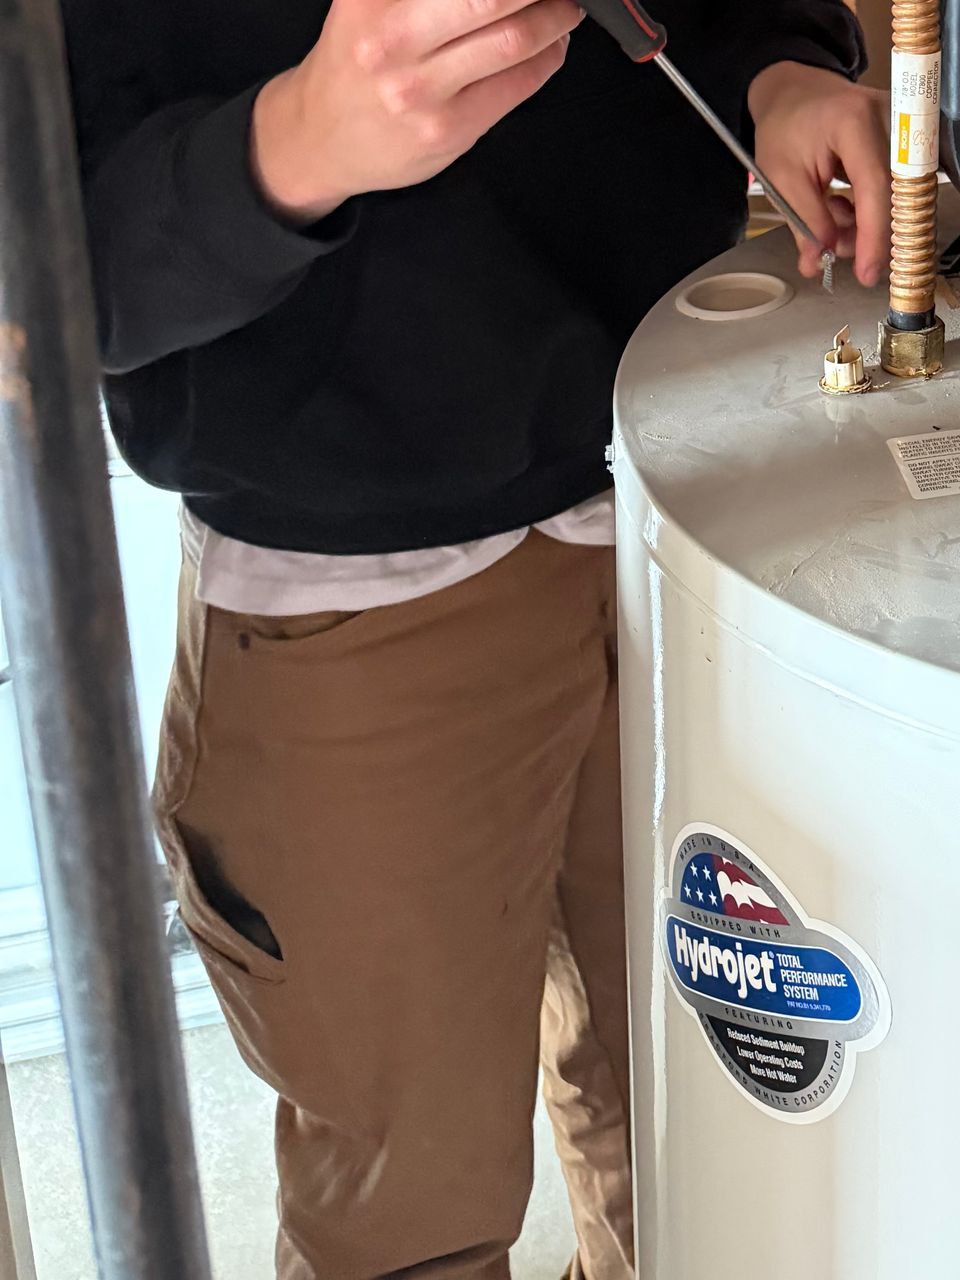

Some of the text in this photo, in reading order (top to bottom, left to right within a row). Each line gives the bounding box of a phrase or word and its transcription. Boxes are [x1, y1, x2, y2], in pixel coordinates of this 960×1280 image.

[910, 73, 918, 97] MODEL
[918, 75, 926, 96] C7800
[679, 839, 697, 860] MADE
[702, 837, 712, 846] IN
[691, 911, 781, 938] EQUIPPED WITH
[776, 953, 804, 969] TOTAL
[780, 970, 848, 987] PERFORMANCE
[783, 985, 819, 1000] SYSTEM
[725, 1007, 793, 1029] FEATURING
[726, 1027, 805, 1056] Reduced Sediment Buildup
[736, 1045, 804, 1070] Lower Operating Costs
[750, 1064, 797, 1084] More Hot Water
[754, 1087, 788, 1106] WHITE
[794, 1040, 842, 1106] CORPORATION
